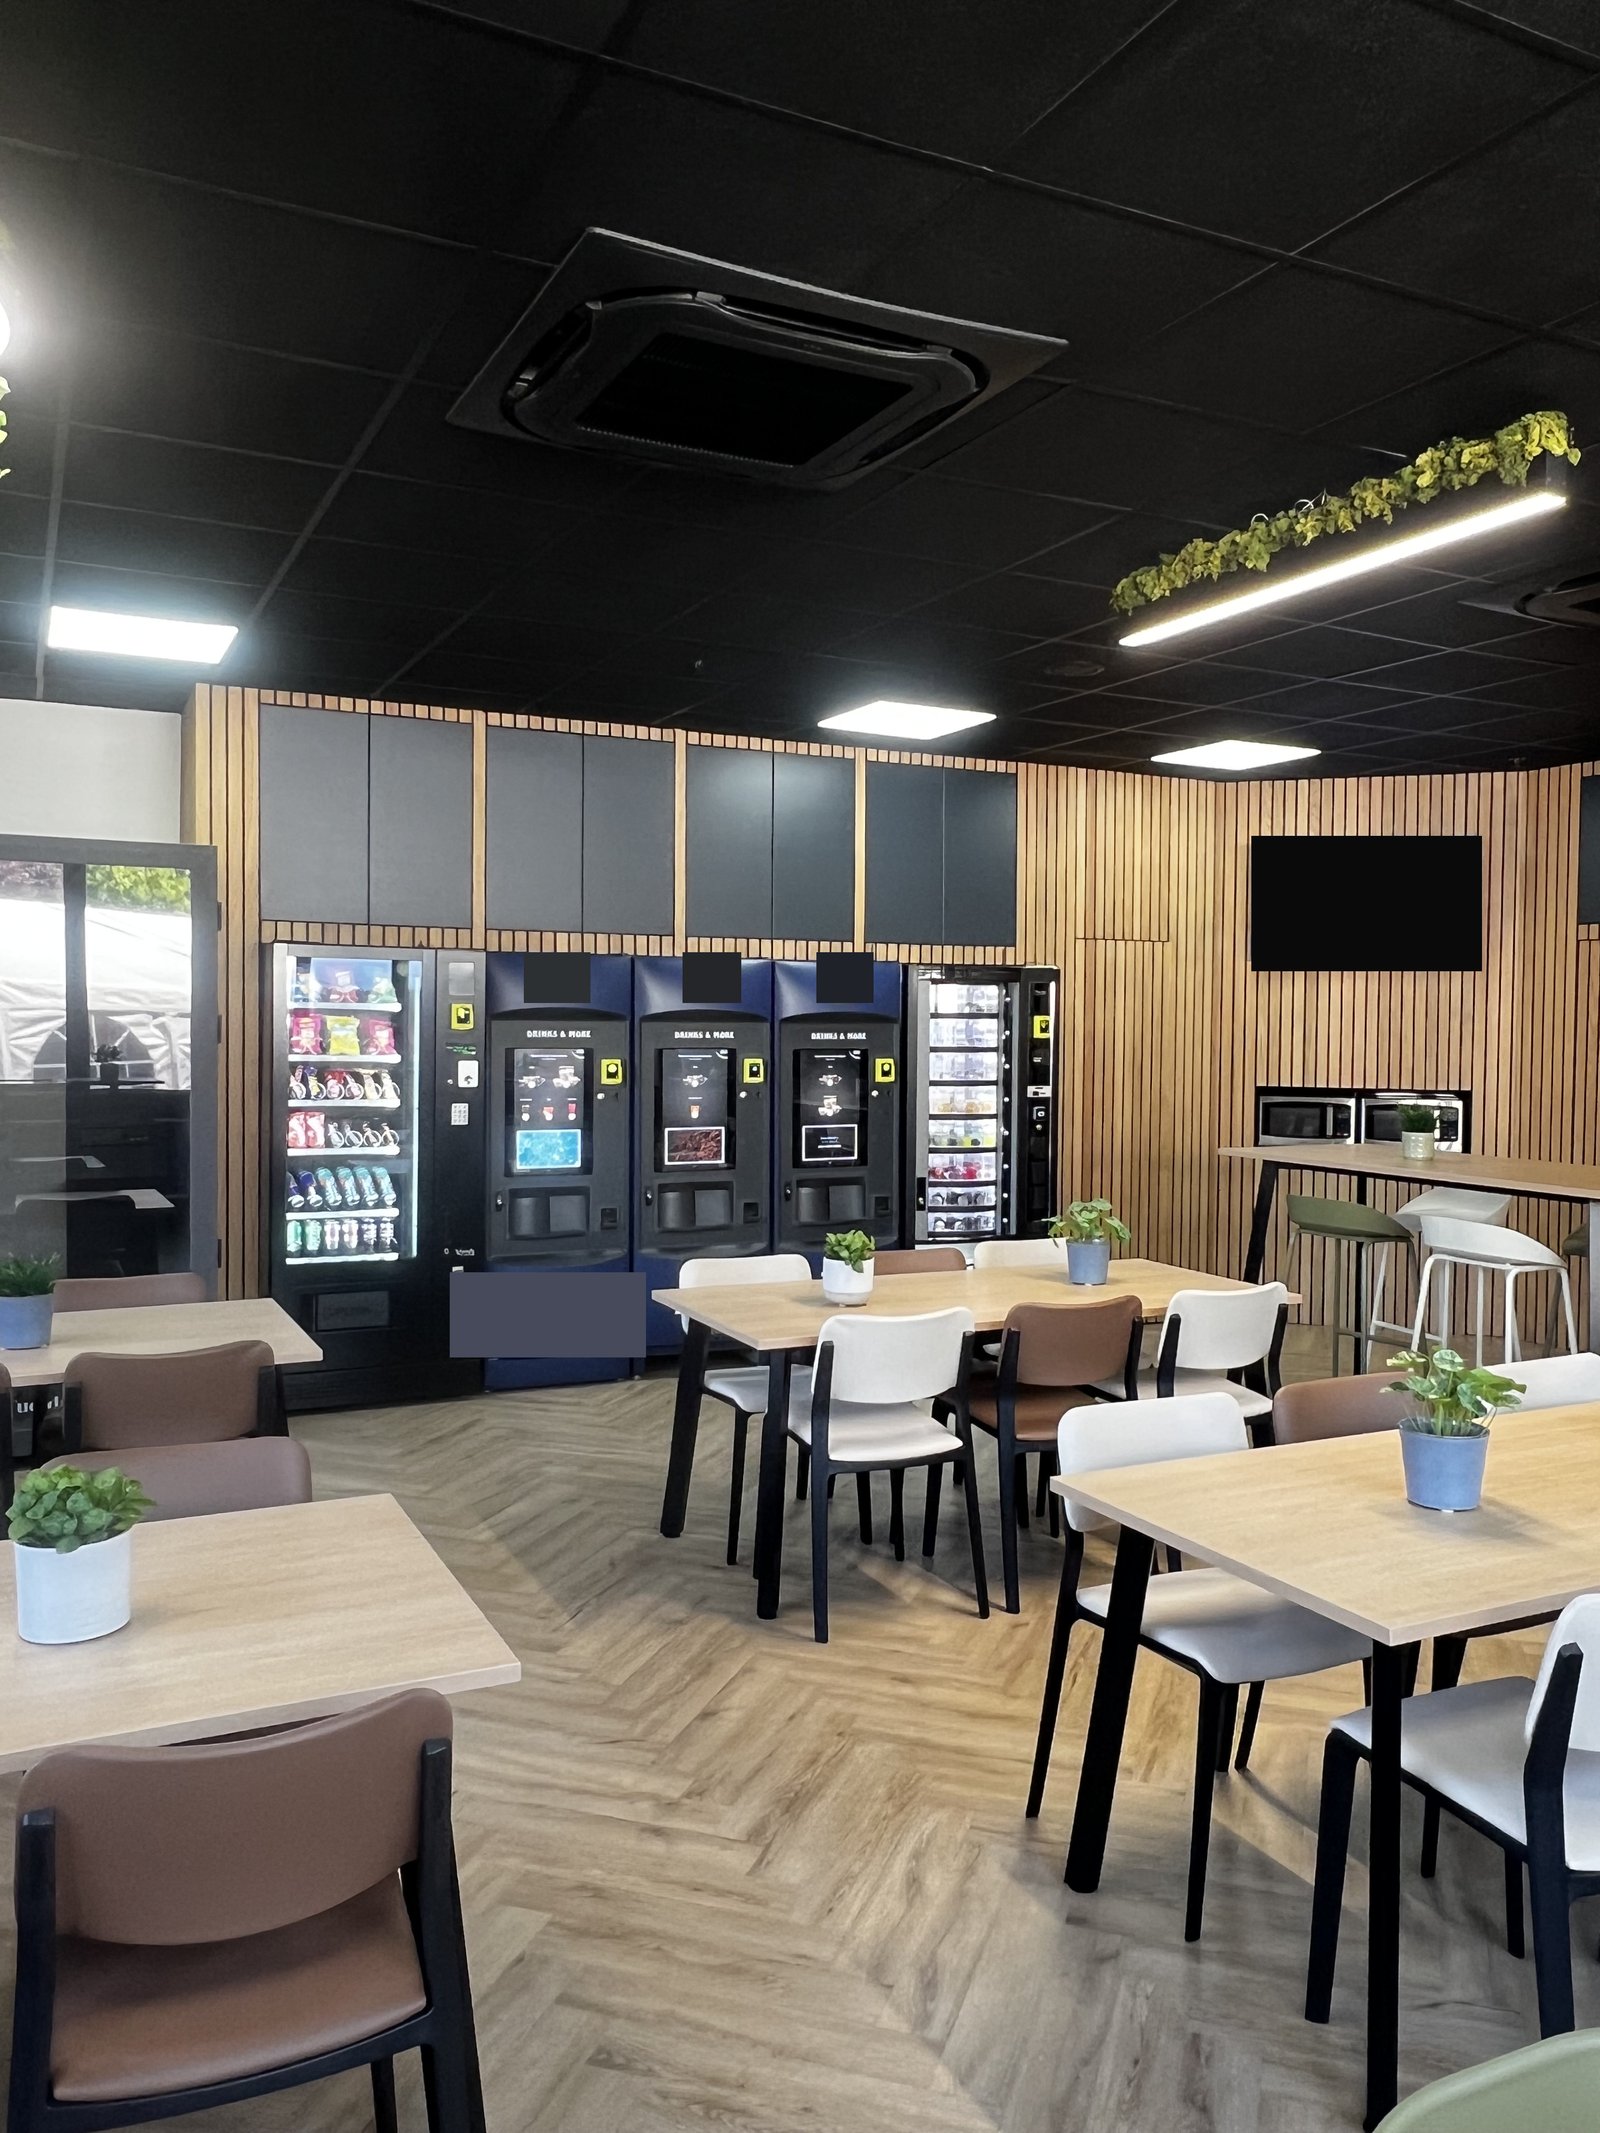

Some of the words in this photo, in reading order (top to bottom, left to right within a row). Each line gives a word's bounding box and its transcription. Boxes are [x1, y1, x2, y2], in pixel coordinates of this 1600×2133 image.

[526, 1030, 558, 1038] DRINKS
[560, 1030, 566, 1038] &
[568, 1030, 592, 1038] MORE
[674, 1031, 703, 1039] DRINKS
[705, 1031, 711, 1039] &
[713, 1031, 735, 1039] MORE
[811, 1032, 838, 1040] DRINKS
[839, 1032, 845, 1040] &
[847, 1032, 867, 1040] MORE
